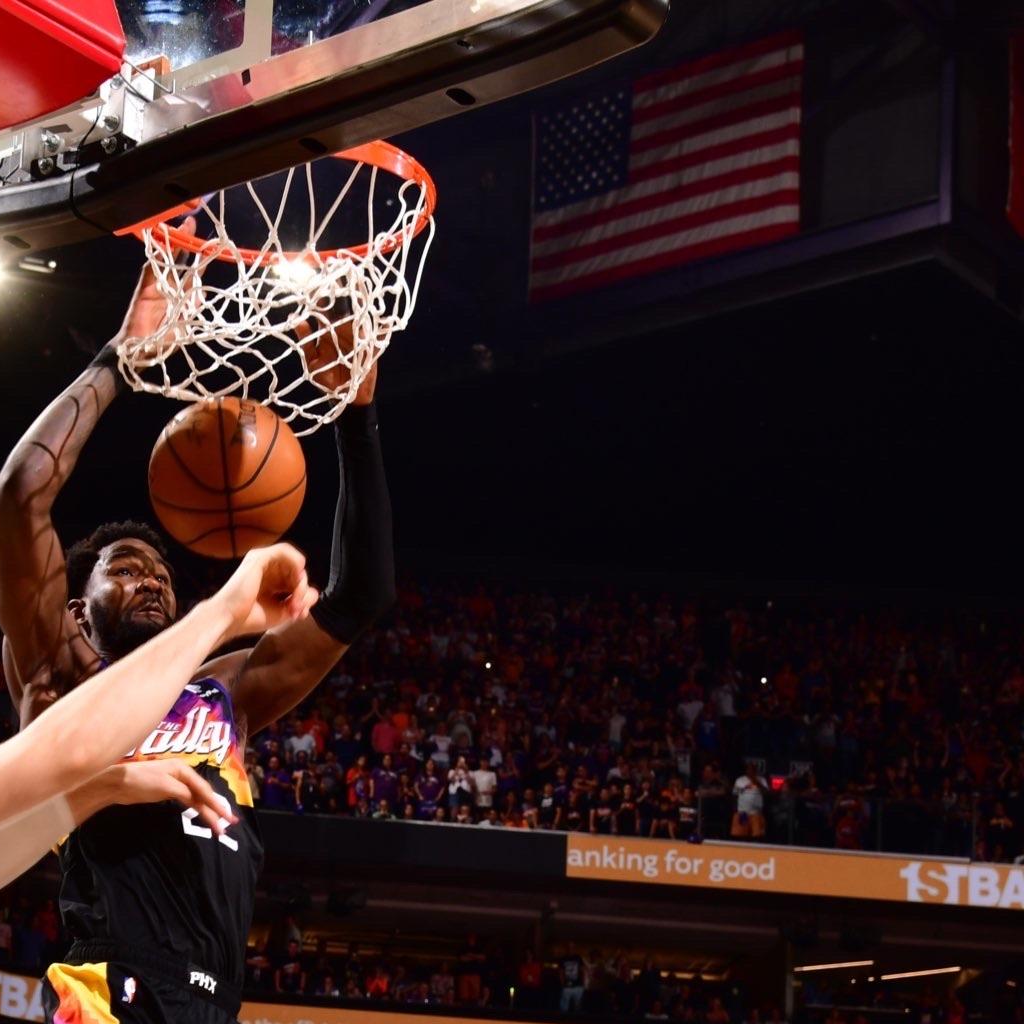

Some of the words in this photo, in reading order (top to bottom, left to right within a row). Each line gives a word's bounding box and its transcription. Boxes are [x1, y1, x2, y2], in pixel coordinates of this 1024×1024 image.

[126, 706, 232, 765] alley
[566, 846, 658, 877] anking
[666, 849, 703, 874] for
[709, 855, 776, 882] good
[189, 971, 218, 994] PHX
